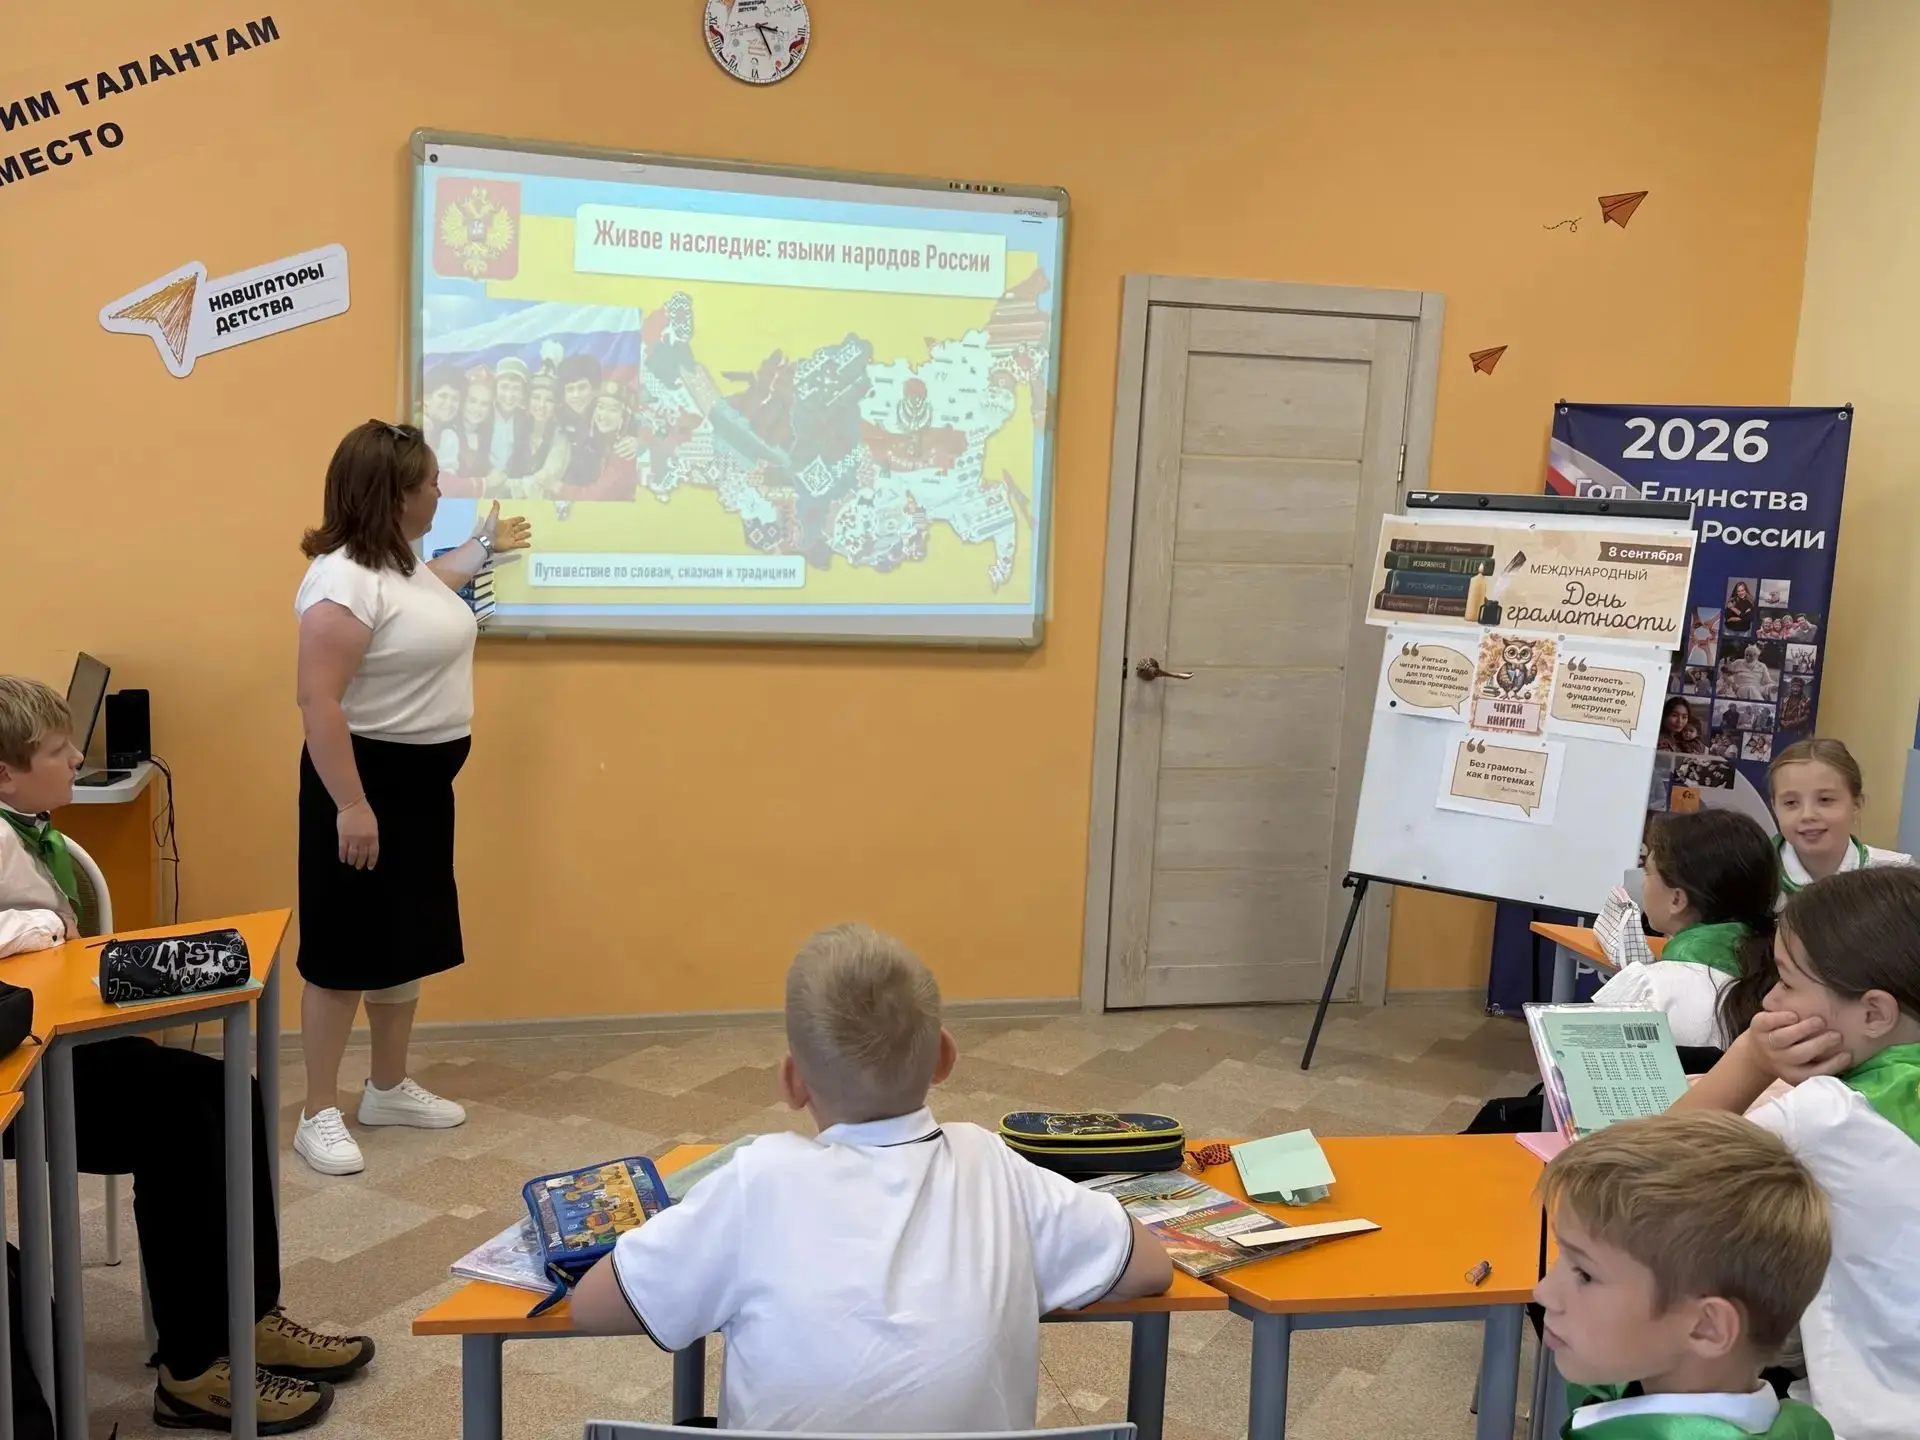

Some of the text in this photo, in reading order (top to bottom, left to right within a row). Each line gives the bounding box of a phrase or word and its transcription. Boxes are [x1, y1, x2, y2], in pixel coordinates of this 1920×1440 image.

[65, 16, 281, 106] ТАЛАНТАМ
[0, 122, 124, 187] МЕСТО
[593, 219, 991, 273] Живое наследие: языки народов России
[208, 263, 325, 313] НАВИГАТОРЫ
[216, 296, 295, 336] ДЕТСТВА
[1622, 417, 1771, 463] 2026
[1575, 477, 1809, 512] Год Единства
[1701, 519, 1826, 550] России
[1608, 546, 1684, 563] 8 сентября
[534, 561, 611, 582] Путешествие
[613, 564, 628, 579] по
[678, 566, 724, 579] сказкам
[726, 567, 734, 580] и
[736, 568, 797, 582] традициям
[1412, 560, 1447, 569] ИЗБРАННОЕ
[1530, 564, 1649, 581] МЕЖДУНАРОДНЫЙ
[1561, 580, 1627, 609] День
[1507, 605, 1678, 633] грамотности
[1421, 655, 1448, 665] Учиться
[1400, 662, 1420, 670] читать
[1426, 665, 1450, 674] писать
[1451, 668, 1469, 677] надо
[1419, 672, 1434, 680] того,
[1436, 674, 1458, 682] чтобы
[1395, 677, 1469, 691] познавать прекрасное
[1568, 672, 1624, 686] Грамотность
[1561, 681, 1636, 698] начало культуры,
[1566, 691, 1628, 707] фундамент ее,
[1493, 702, 1523, 715] ЧИТАЙ
[1570, 702, 1622, 715] инструмент
[1486, 715, 1526, 729] КНИГИ!!!
[1469, 759, 1486, 768] Без
[1486, 762, 1527, 775] грамоты
[1466, 770, 1535, 787] как в потемках
[1163, 1208, 1220, 1227] ДНЕВНИК
